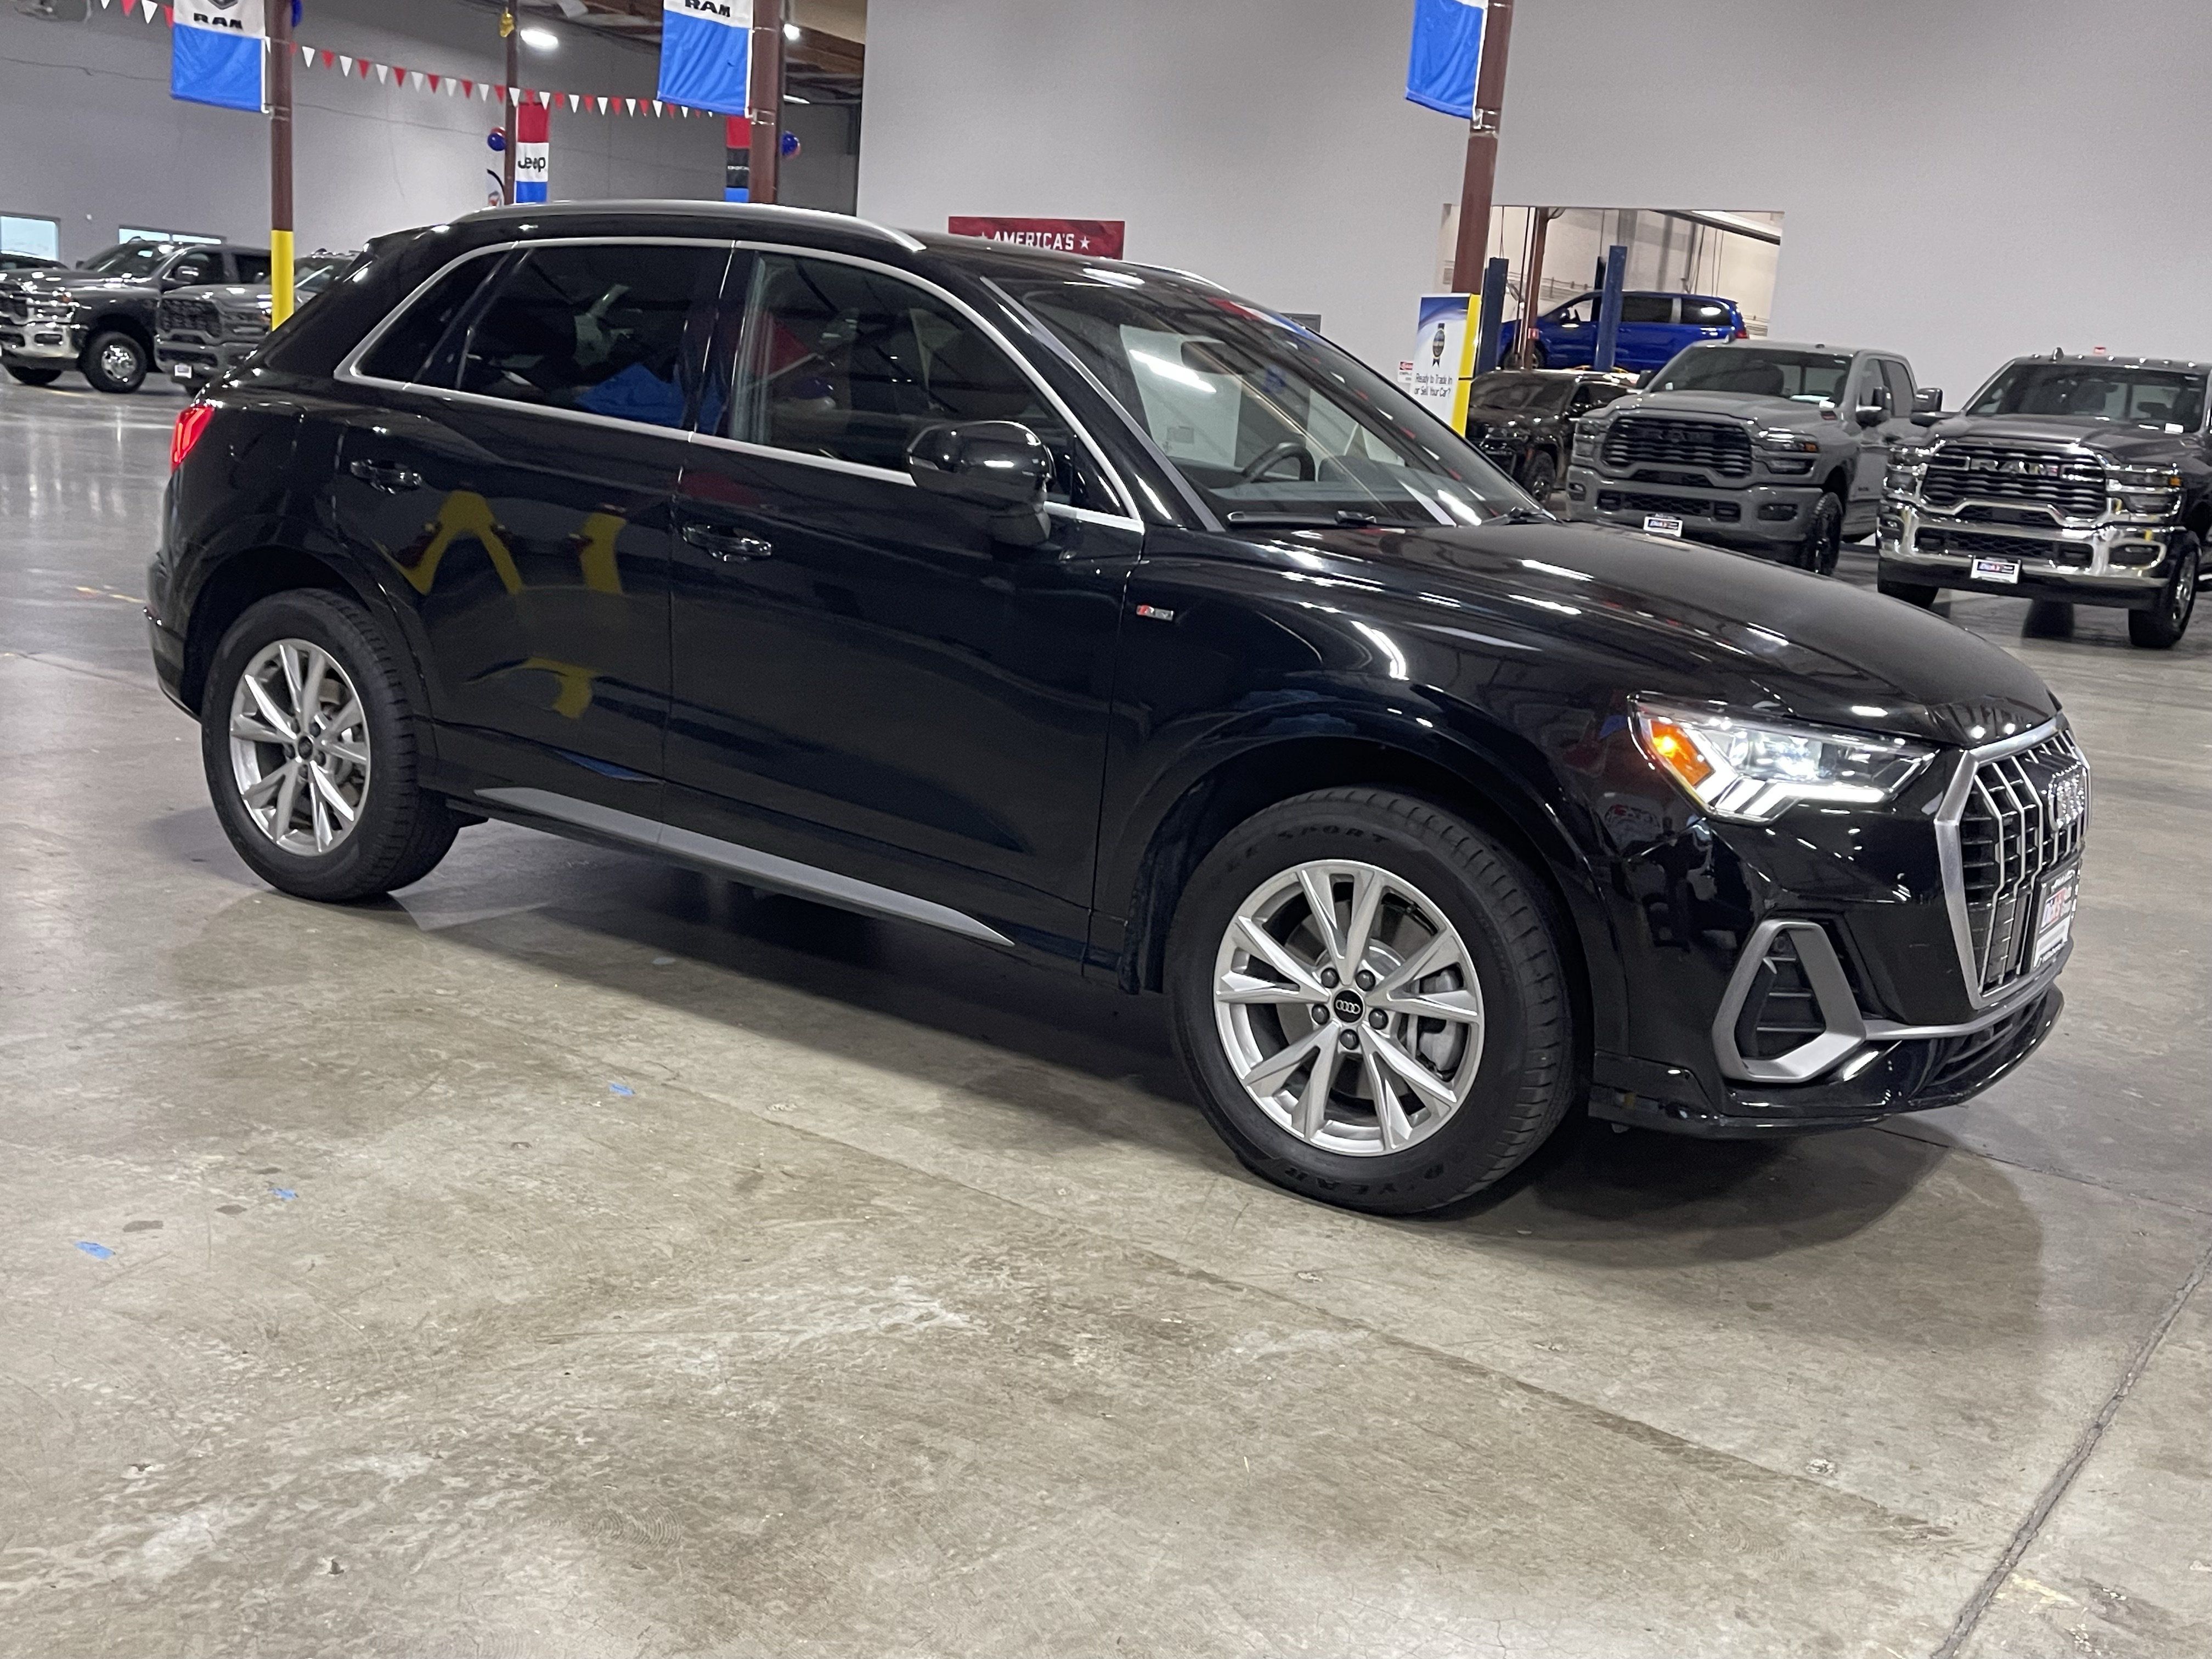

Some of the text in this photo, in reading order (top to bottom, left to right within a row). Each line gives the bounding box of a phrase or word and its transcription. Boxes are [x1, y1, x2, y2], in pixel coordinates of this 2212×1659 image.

[685, 0, 730, 18] RAM
[193, 13, 243, 30] RAM
[517, 155, 546, 173] Jeep
[994, 231, 1075, 251] AMERICA'S
